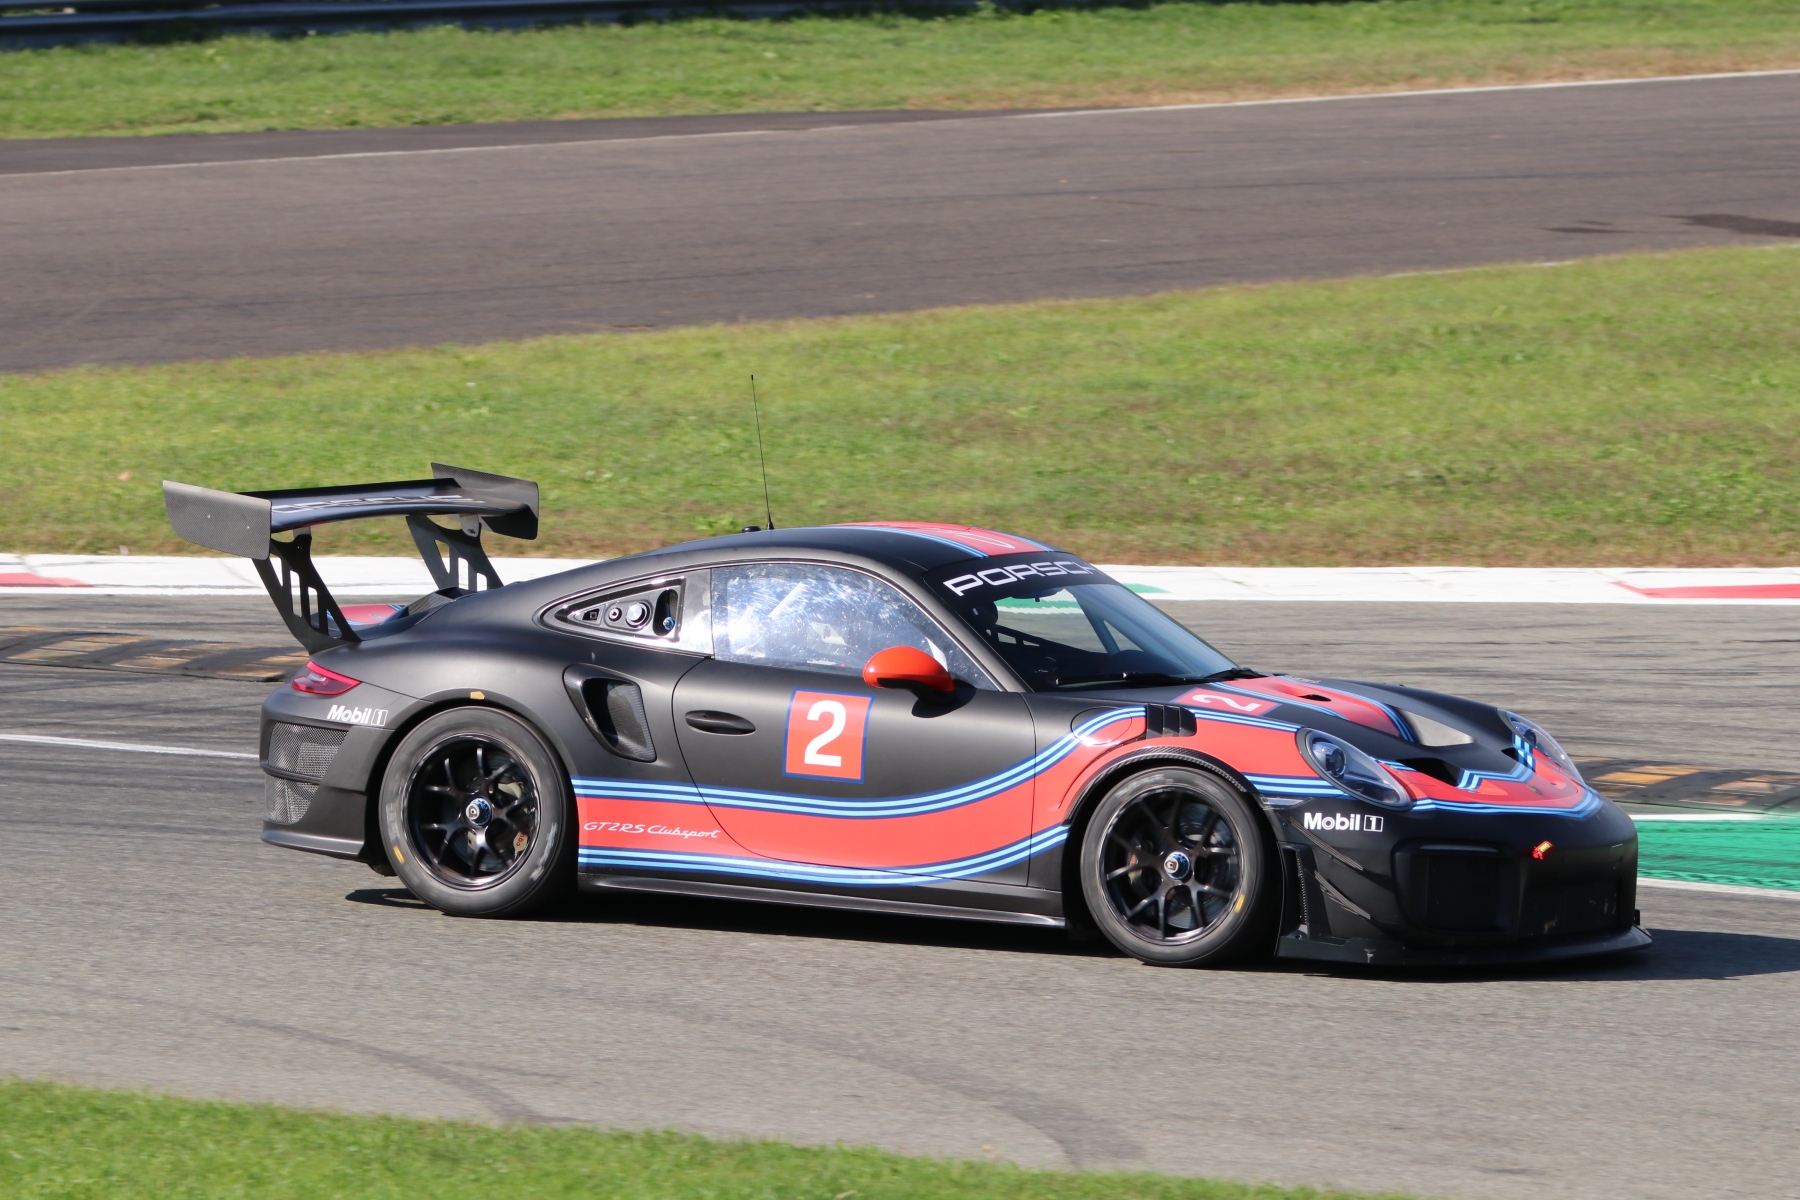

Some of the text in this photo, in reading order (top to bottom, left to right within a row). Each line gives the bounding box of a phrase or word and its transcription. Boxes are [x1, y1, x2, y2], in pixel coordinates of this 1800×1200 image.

[1192, 694, 1262, 712] 2
[326, 704, 372, 725] Mobil
[803, 699, 847, 768] 2
[1303, 811, 1361, 831] Mobil
[647, 824, 721, 840] Clubsport
